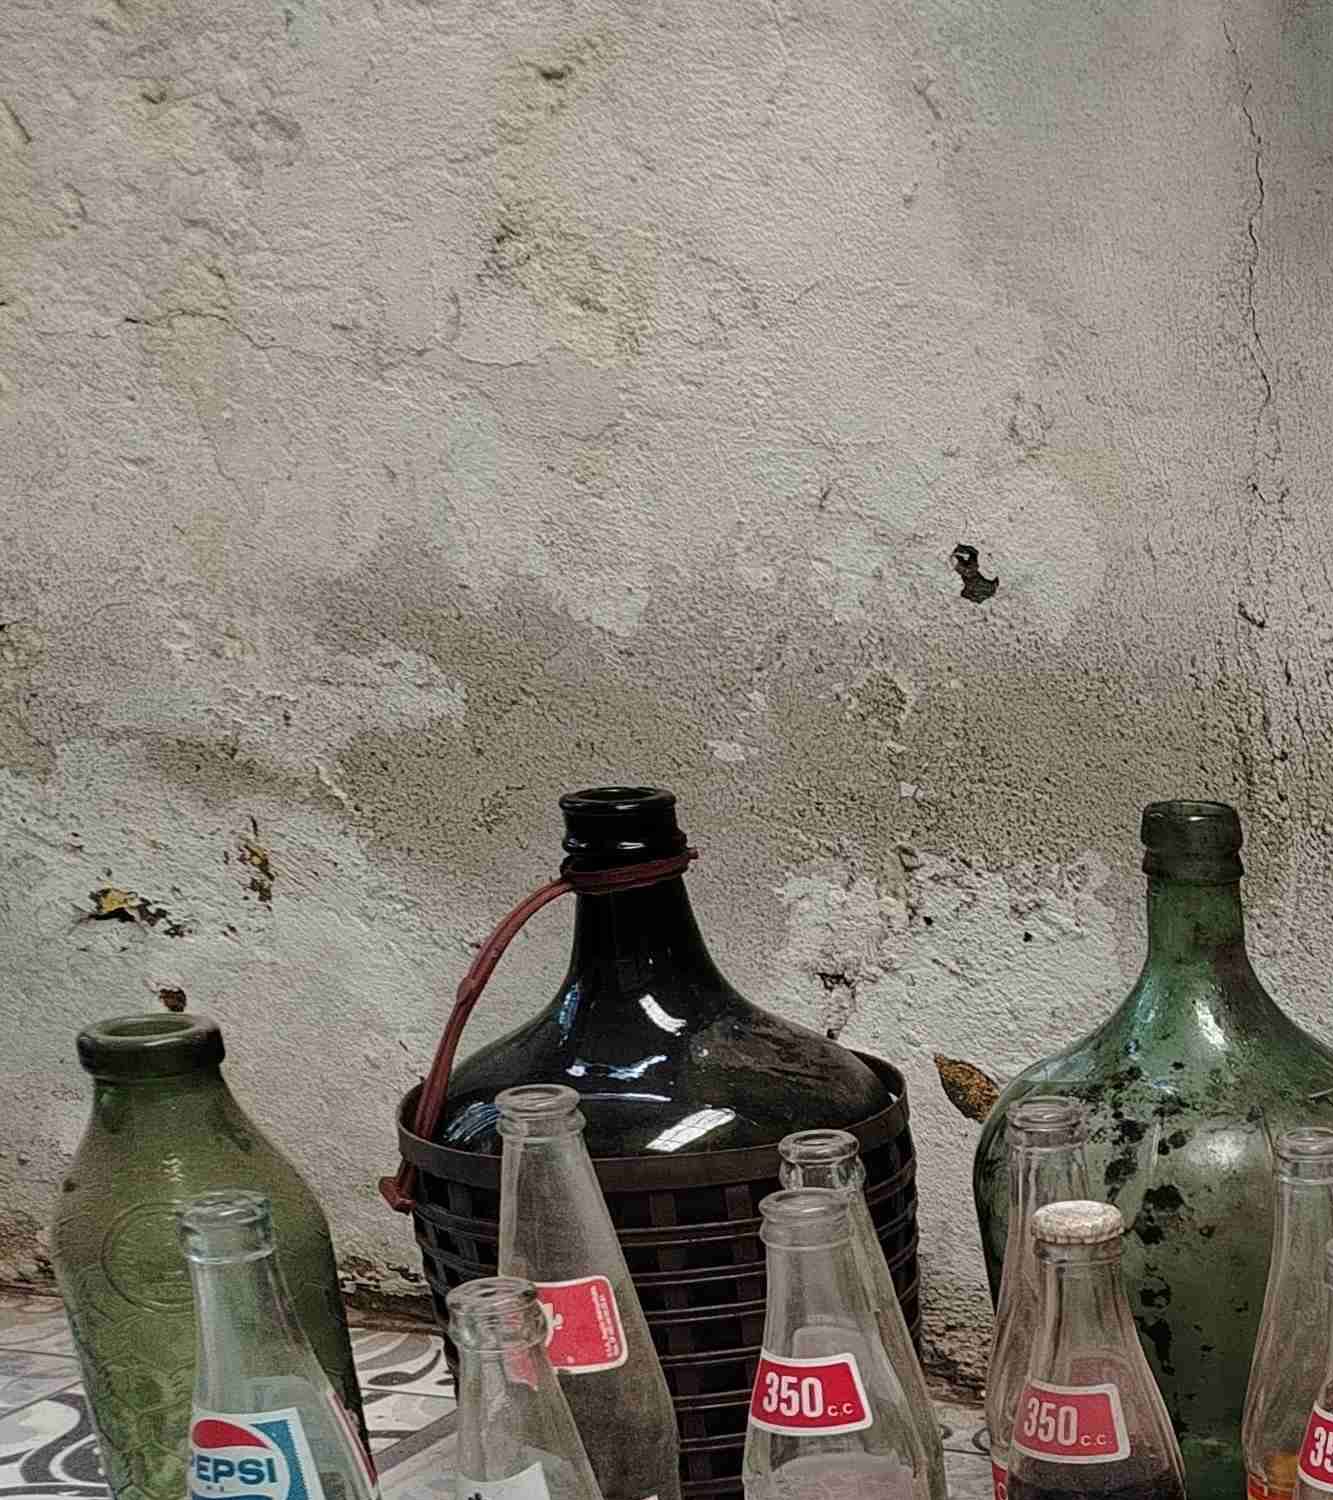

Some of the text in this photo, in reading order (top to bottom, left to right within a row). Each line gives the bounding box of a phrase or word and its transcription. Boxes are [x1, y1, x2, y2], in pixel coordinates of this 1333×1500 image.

[763, 1371, 824, 1418] 350
[1023, 1396, 1078, 1447] 350
[192, 1454, 278, 1485] EPSI
